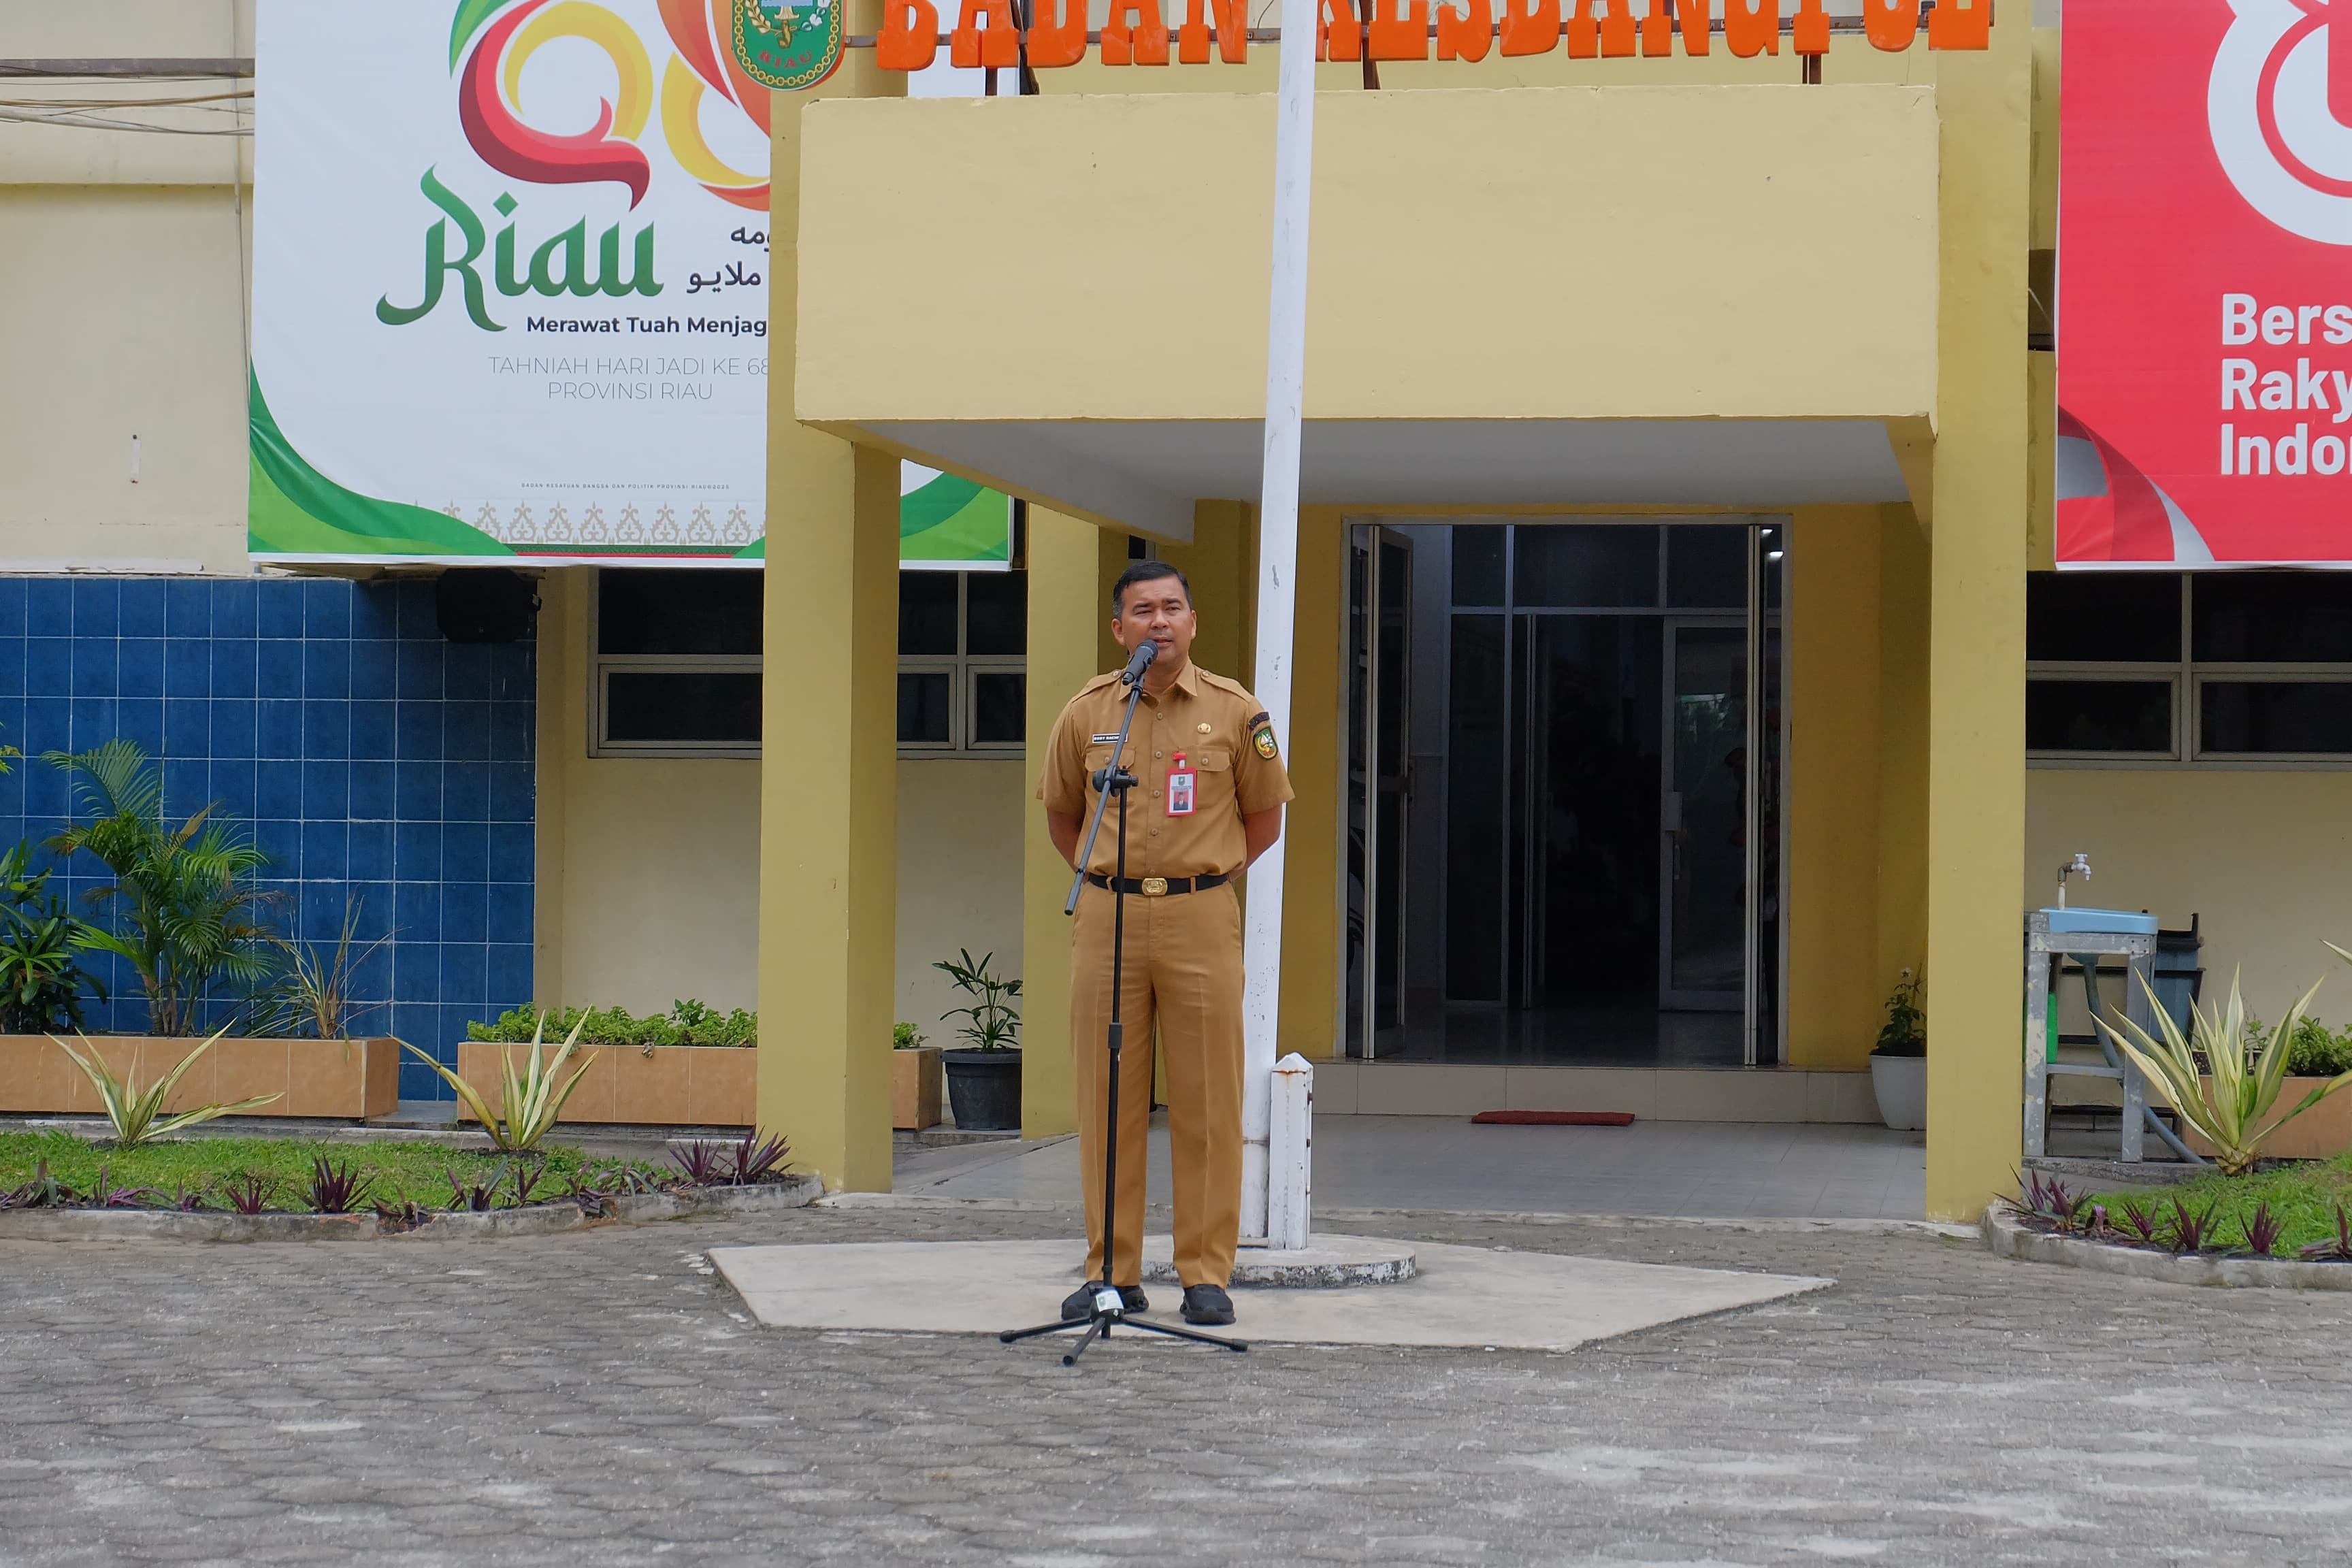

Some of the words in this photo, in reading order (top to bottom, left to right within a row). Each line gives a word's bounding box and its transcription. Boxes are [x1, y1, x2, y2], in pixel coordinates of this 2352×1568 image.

[759, 50, 813, 68] RIAU
[376, 162, 664, 331] Riau
[687, 261, 762, 293] ملايو
[527, 316, 620, 333] Merawat
[626, 316, 680, 333] Tuah
[687, 315, 767, 337] Menjag
[2222, 293, 2352, 345] Bers
[488, 357, 589, 374] TAHNIAH
[597, 357, 649, 374] HARI
[655, 357, 704, 375] JADI
[713, 358, 740, 375] KE
[549, 382, 653, 399] PROVINSI
[662, 382, 713, 400] RIAU
[2222, 358, 2352, 423] Raky
[2221, 423, 2352, 475] Indo
